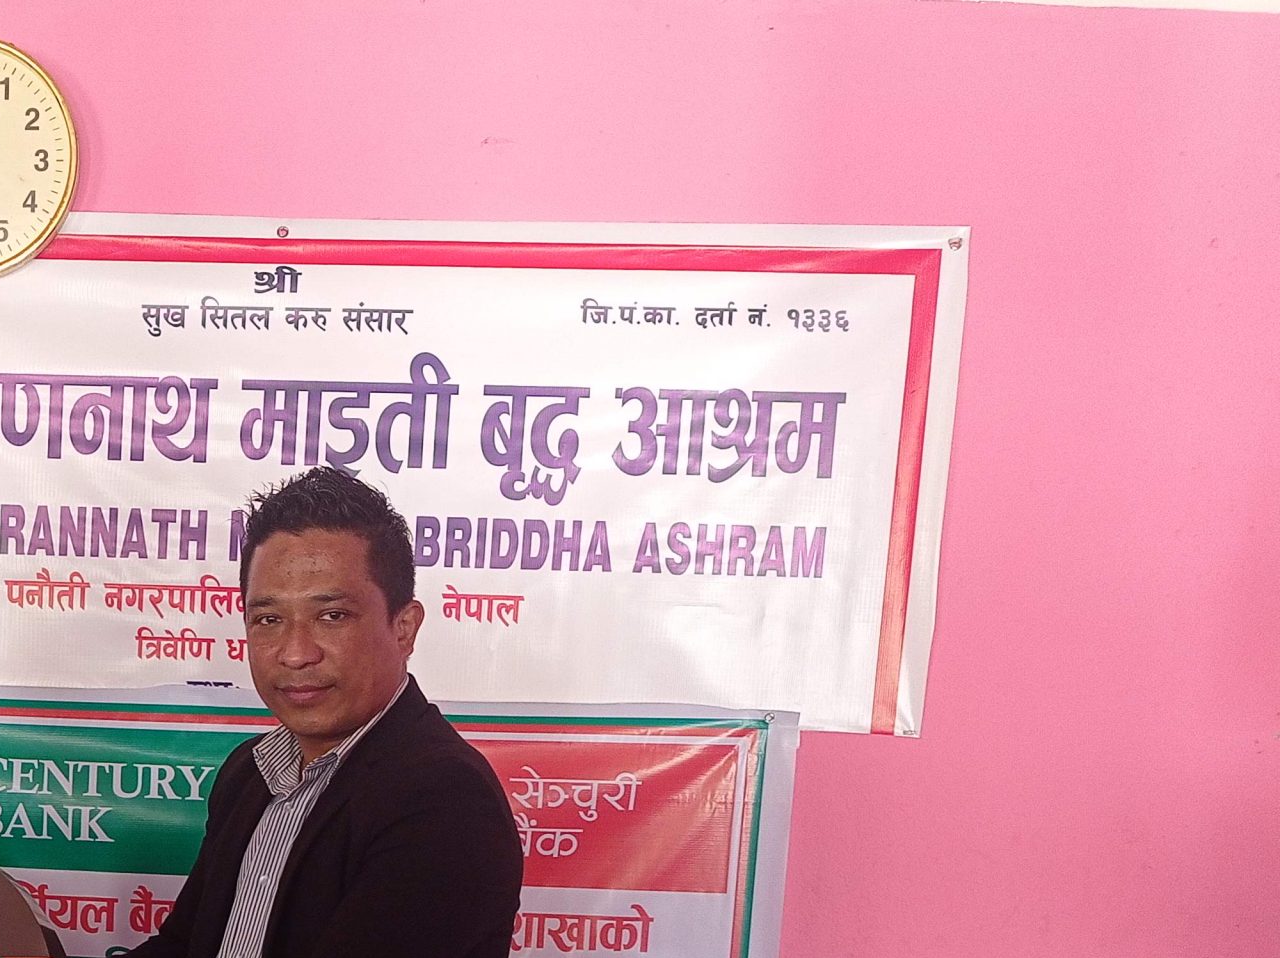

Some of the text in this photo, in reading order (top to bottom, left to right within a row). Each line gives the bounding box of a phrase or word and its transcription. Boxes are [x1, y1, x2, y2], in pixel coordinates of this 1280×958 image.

[0, 77, 10, 100] 1
[24, 108, 40, 131] 2
[34, 149, 49, 172] 3
[22, 190, 38, 213] 4
[254, 265, 302, 293] श्री
[142, 304, 189, 337] सुख
[200, 296, 273, 331] सितल
[342, 301, 414, 335] संसार
[694, 301, 737, 329] दर्ता
[787, 307, 850, 332] १३३६
[240, 351, 459, 476] माइती
[612, 386, 847, 483] आश्रम
[416, 516, 612, 572] BRIDDHA
[632, 522, 827, 578] ASHRAM
[4, 567, 525, 627] पनौती नगरपालि नेपाल
[134, 626, 216, 661] त्रिवेणि
[509, 765, 643, 822] सेञ्चुरी
